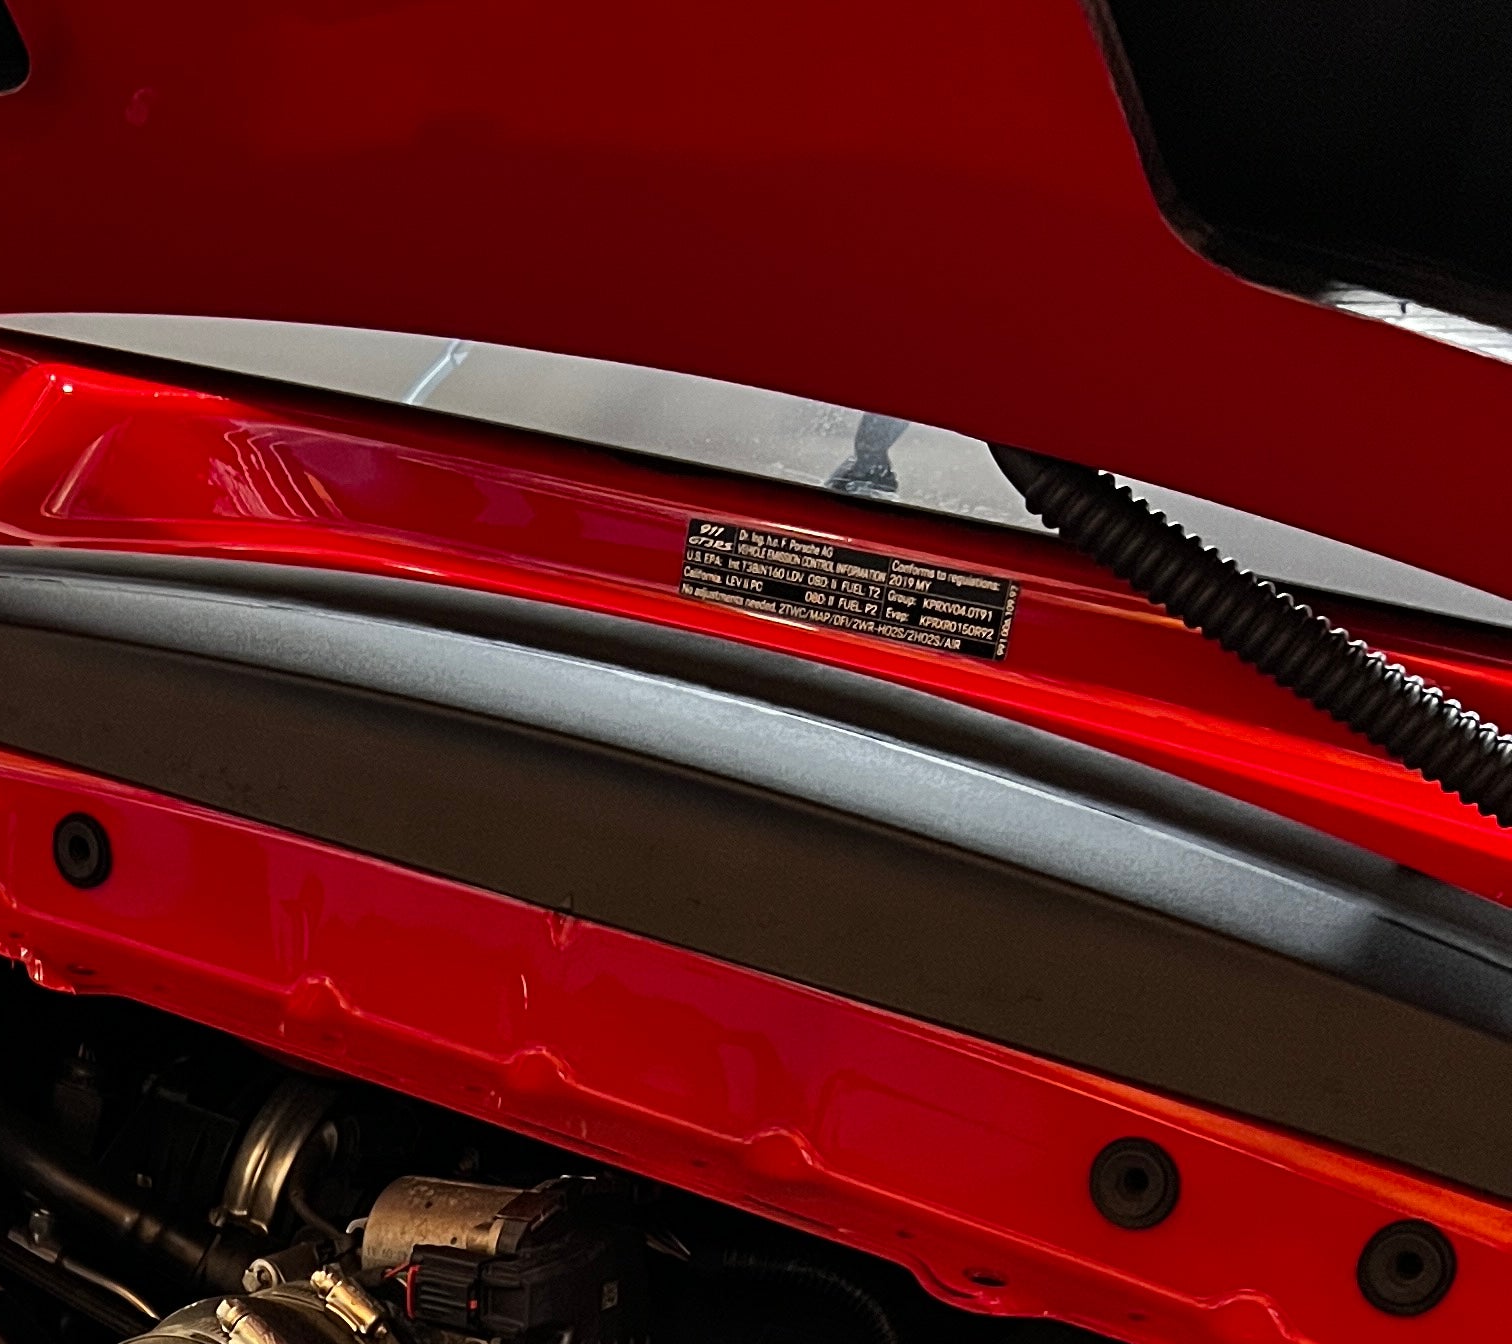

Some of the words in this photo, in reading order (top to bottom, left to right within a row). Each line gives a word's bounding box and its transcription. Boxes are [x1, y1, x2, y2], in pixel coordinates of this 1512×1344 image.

[700, 524, 725, 537] 911
[789, 539, 820, 556] Porsche
[821, 545, 834, 559] AG
[738, 543, 767, 559] VEHICLE
[767, 549, 801, 565] EMISSION
[801, 556, 834, 573] CONTROL
[835, 562, 887, 582] INFORMATION
[786, 570, 805, 583] LDV
[868, 585, 881, 599] T2
[888, 573, 915, 589] 2019
[915, 579, 932, 592] MY
[892, 559, 935, 579] Conforms
[937, 570, 947, 581] to
[948, 573, 1001, 591] regulations:
[681, 583, 693, 595] No
[694, 587, 744, 606] adjustments
[725, 575, 742, 588] LEV
[750, 580, 763, 592] PC
[865, 603, 878, 616] P2
[888, 590, 917, 607] Group:
[885, 607, 909, 623] Evap:
